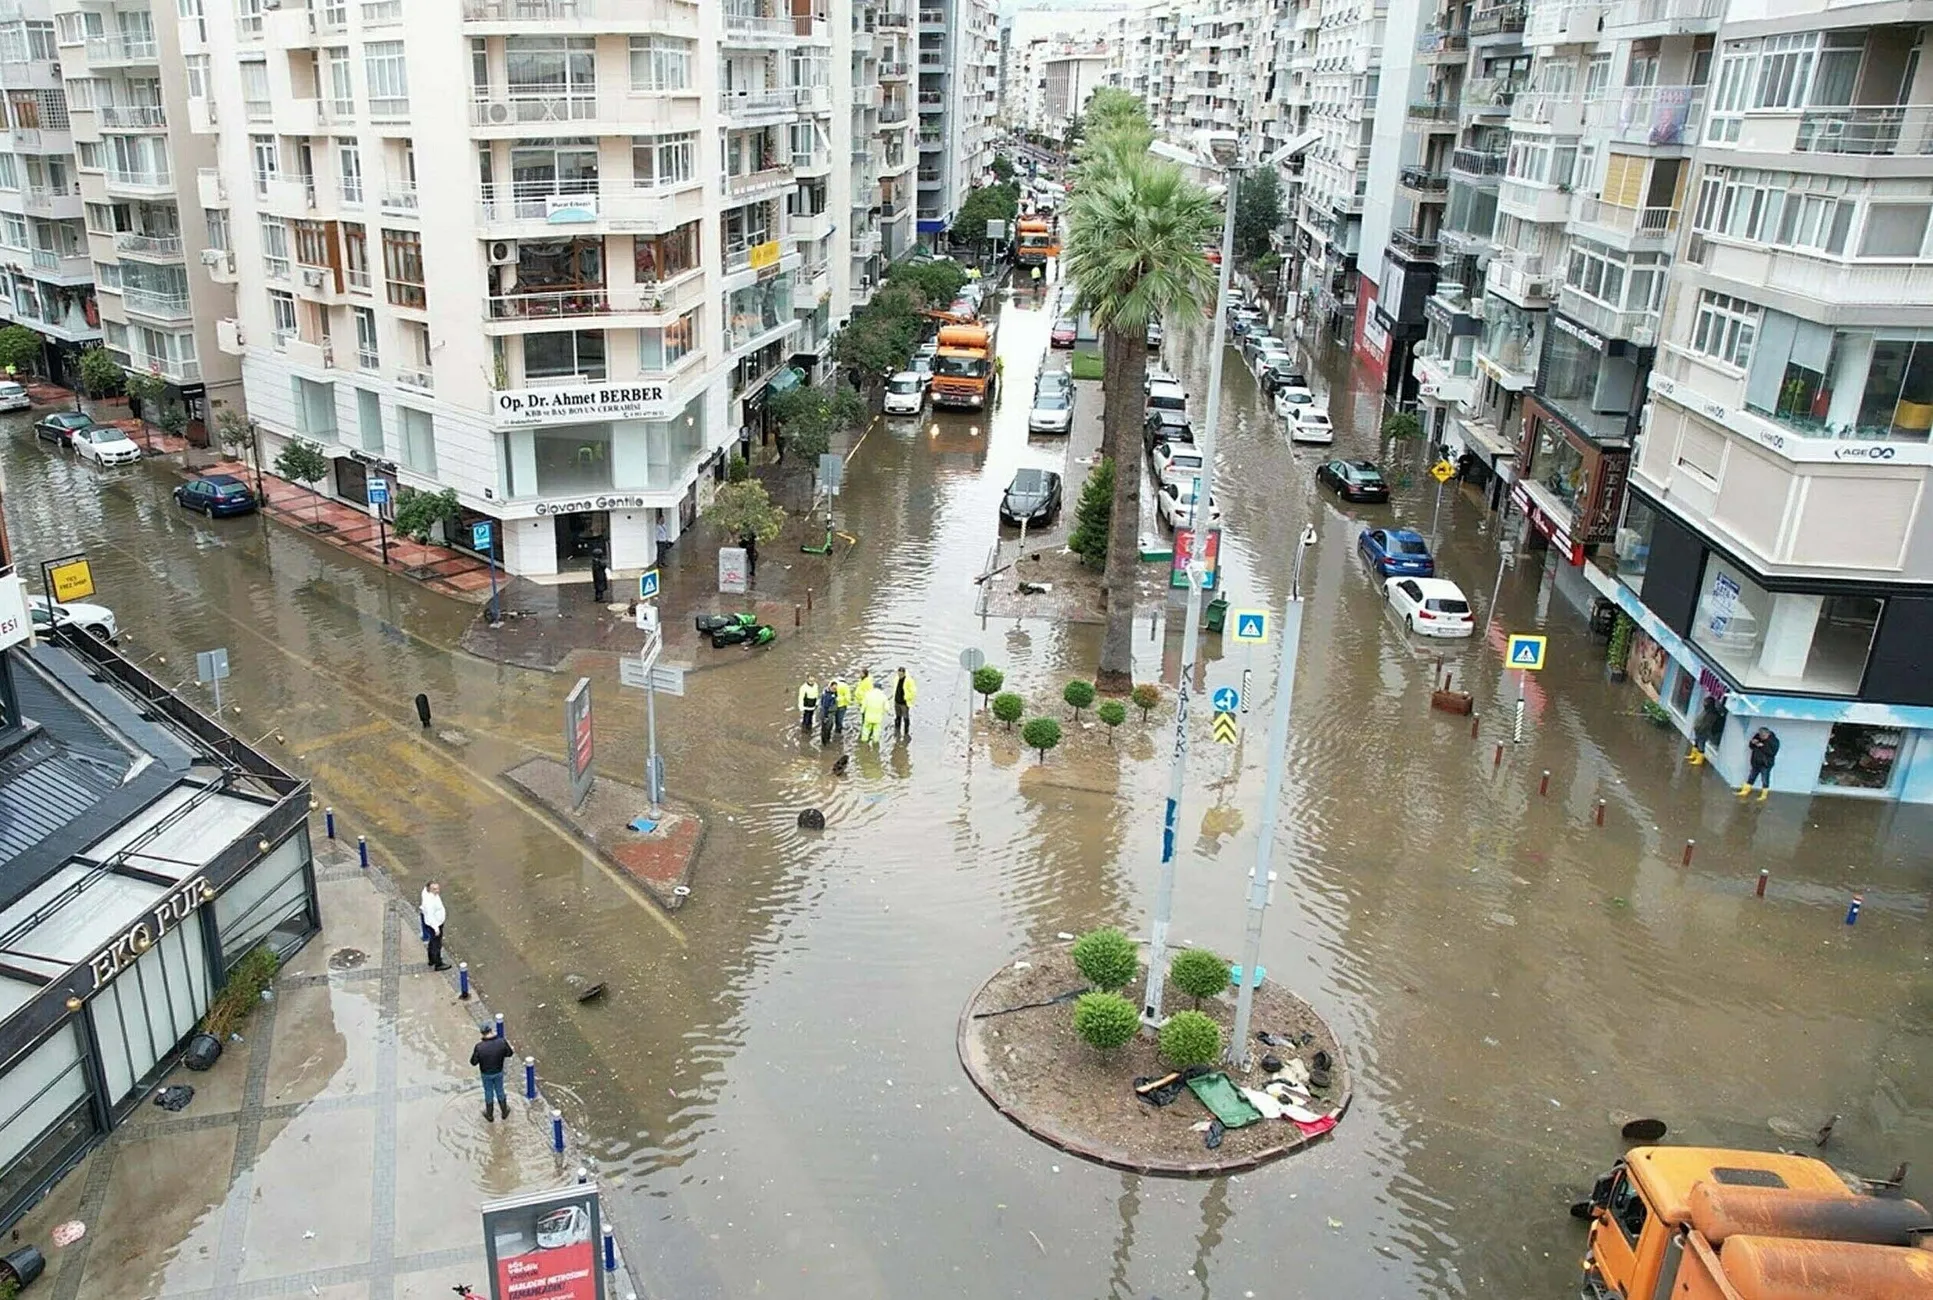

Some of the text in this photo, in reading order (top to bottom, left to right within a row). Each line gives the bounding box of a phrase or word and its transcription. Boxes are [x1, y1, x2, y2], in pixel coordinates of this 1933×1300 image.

[79, 339, 104, 349] TWIS
[500, 387, 662, 409] Op. Dr. Ahmet BERBER
[1, 615, 18, 634] ESİ
